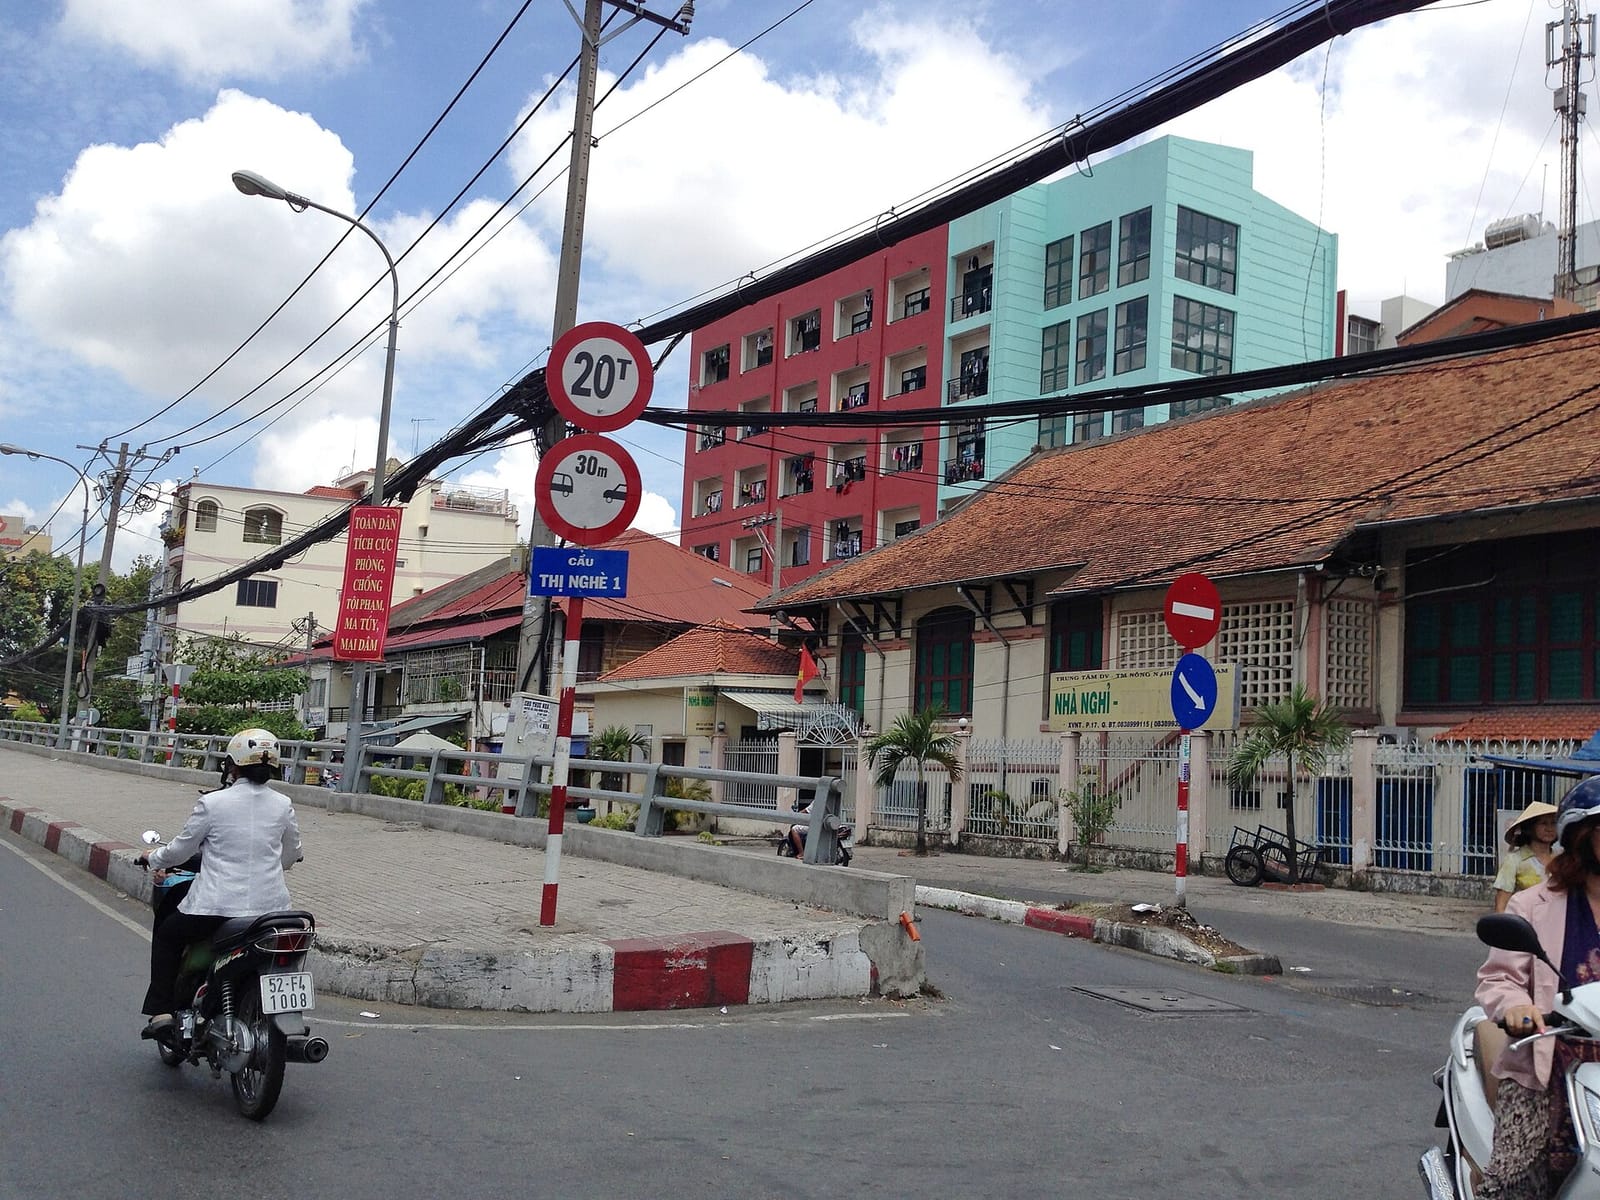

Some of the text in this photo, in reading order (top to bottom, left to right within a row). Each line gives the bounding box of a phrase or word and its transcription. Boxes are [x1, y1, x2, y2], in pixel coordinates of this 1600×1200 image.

[571, 351, 632, 399] 20T
[575, 454, 608, 478] 30m
[354, 514, 397, 531] TOÀN DÂN
[353, 534, 393, 554] TÍCH CỰC
[354, 556, 386, 573] PHÒNG,
[353, 575, 383, 592] CHỐNG
[539, 572, 621, 592] THỊ NGHÈ 1
[346, 597, 385, 614] TỘI PHẠM,
[344, 616, 380, 632] MA TÚY,
[340, 635, 378, 654] MẠI DÂM
[1054, 687, 1077, 715] NHÀ
[1081, 682, 1110, 715] NGHỈ
[270, 992, 307, 1010] 1008
